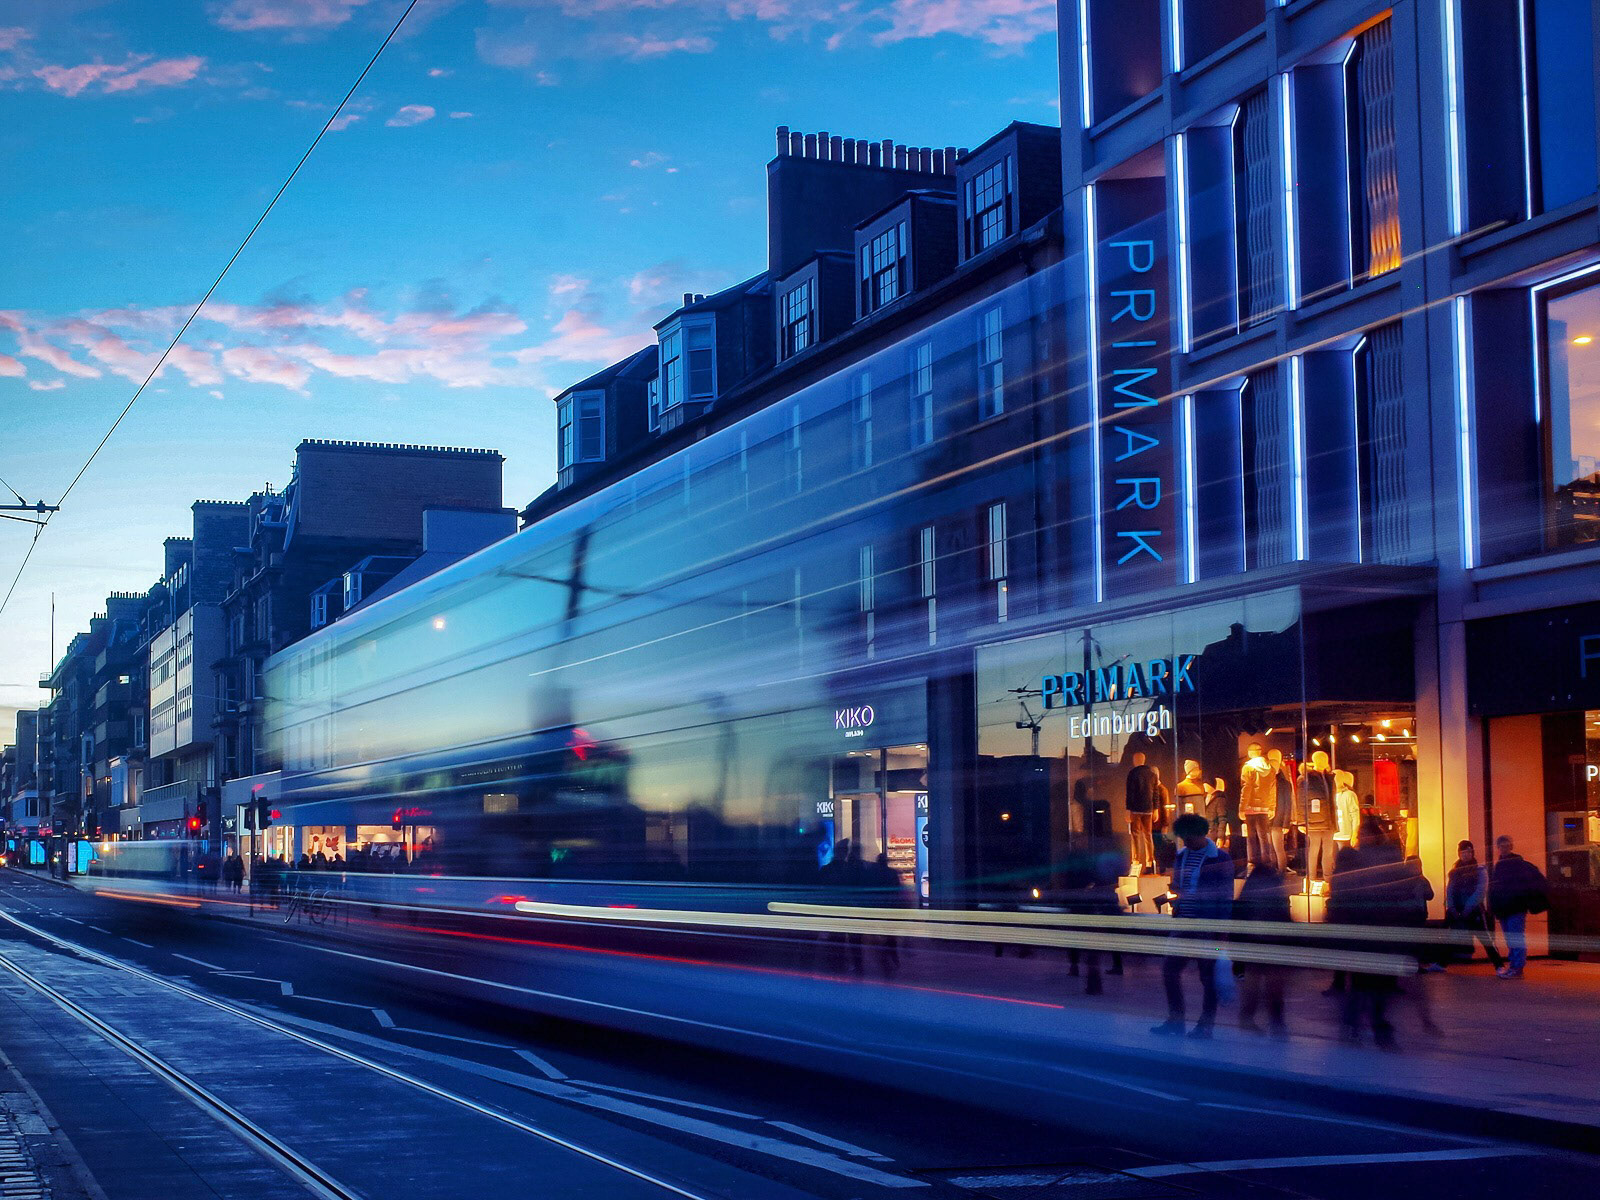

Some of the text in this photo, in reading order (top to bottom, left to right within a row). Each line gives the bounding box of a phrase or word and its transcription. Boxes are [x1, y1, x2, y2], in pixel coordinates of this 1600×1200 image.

[1109, 240, 1163, 565] PRIMARK
[1042, 655, 1195, 709] PRIMARK
[835, 705, 874, 729] KIKO
[1070, 705, 1172, 739] Edinburgh
